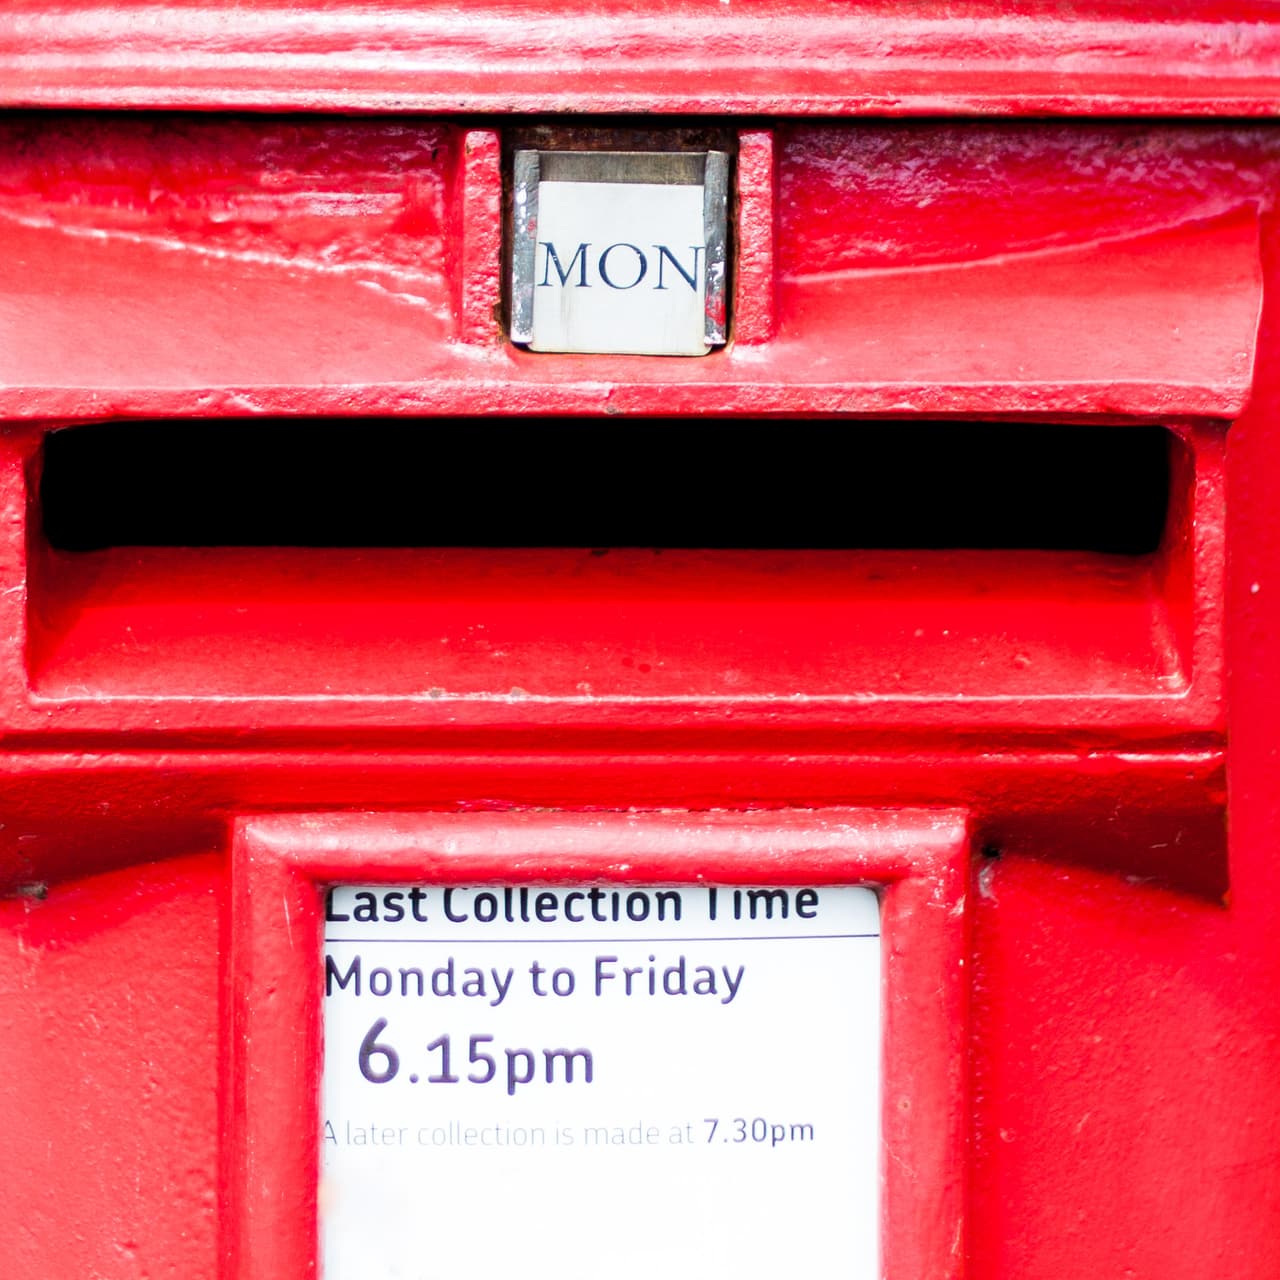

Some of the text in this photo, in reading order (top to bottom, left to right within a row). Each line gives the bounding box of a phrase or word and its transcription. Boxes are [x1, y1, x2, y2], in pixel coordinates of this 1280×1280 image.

[537, 241, 705, 292] MON
[325, 887, 428, 923] Last
[443, 887, 682, 923] Collection
[325, 954, 746, 1007] Monday to Friday
[358, 1017, 593, 1096] 6.15pm
[324, 1117, 815, 1148] A later collection is made at 7.30pm
